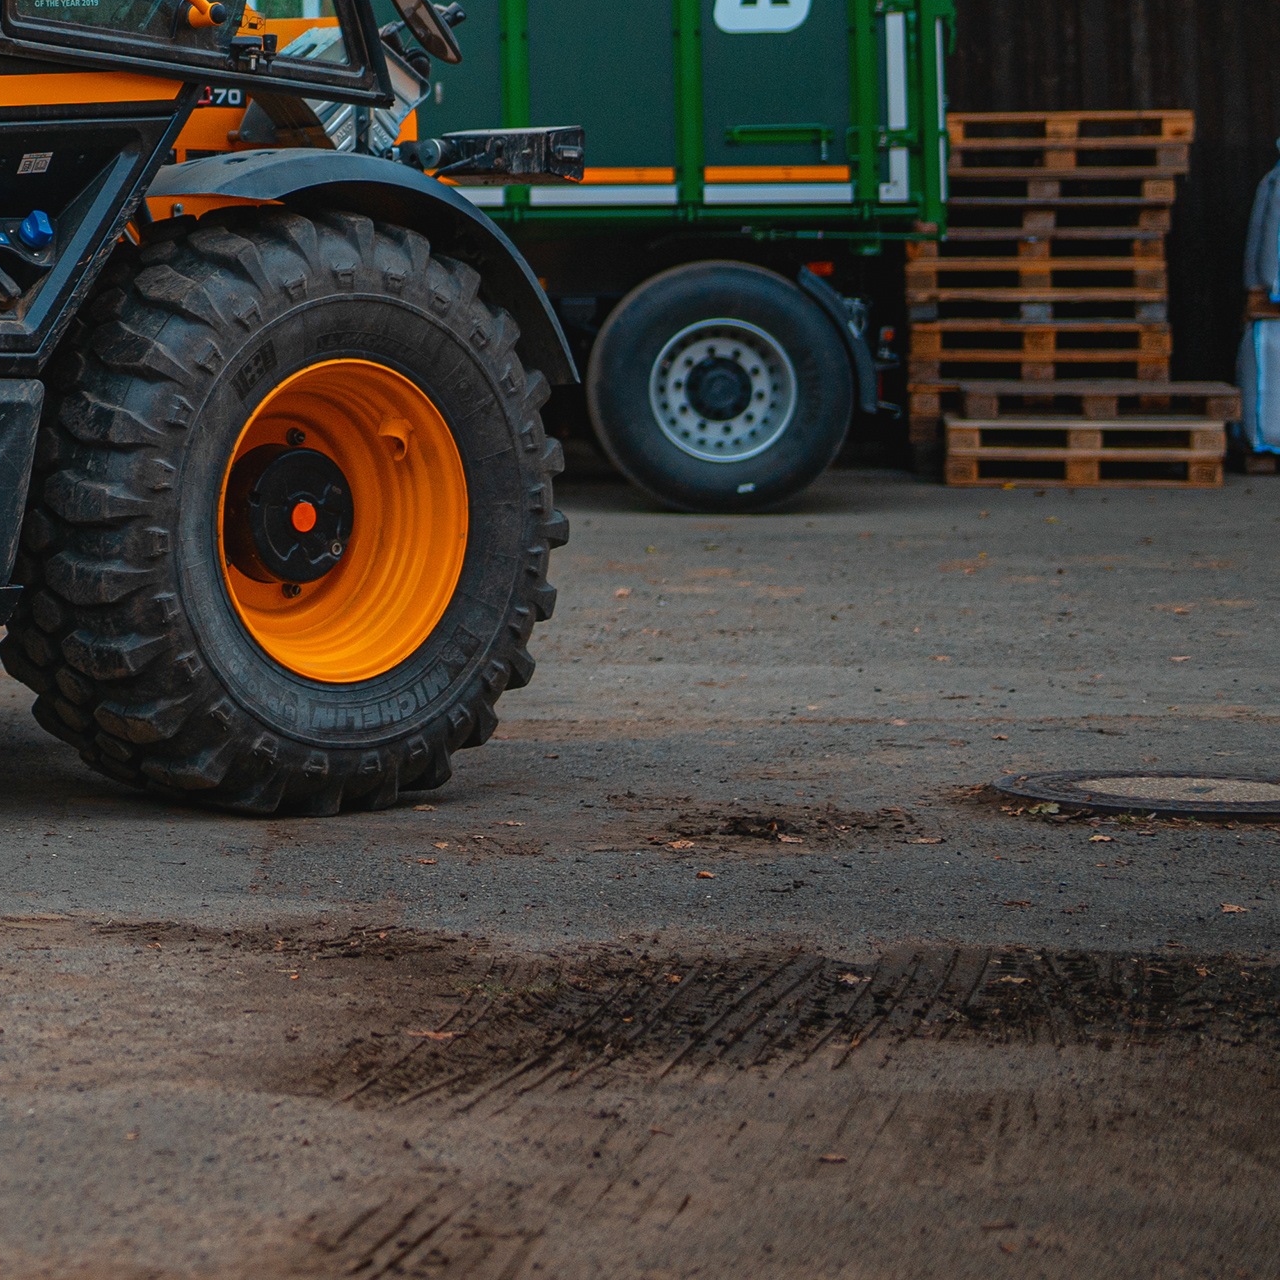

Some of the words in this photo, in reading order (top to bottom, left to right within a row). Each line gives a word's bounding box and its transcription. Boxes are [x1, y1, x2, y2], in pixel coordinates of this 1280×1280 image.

[34, 0, 44, 8] OF
[46, 0, 59, 8] THE
[61, 0, 80, 7] YEAR
[311, 663, 451, 731] MICHELIN
